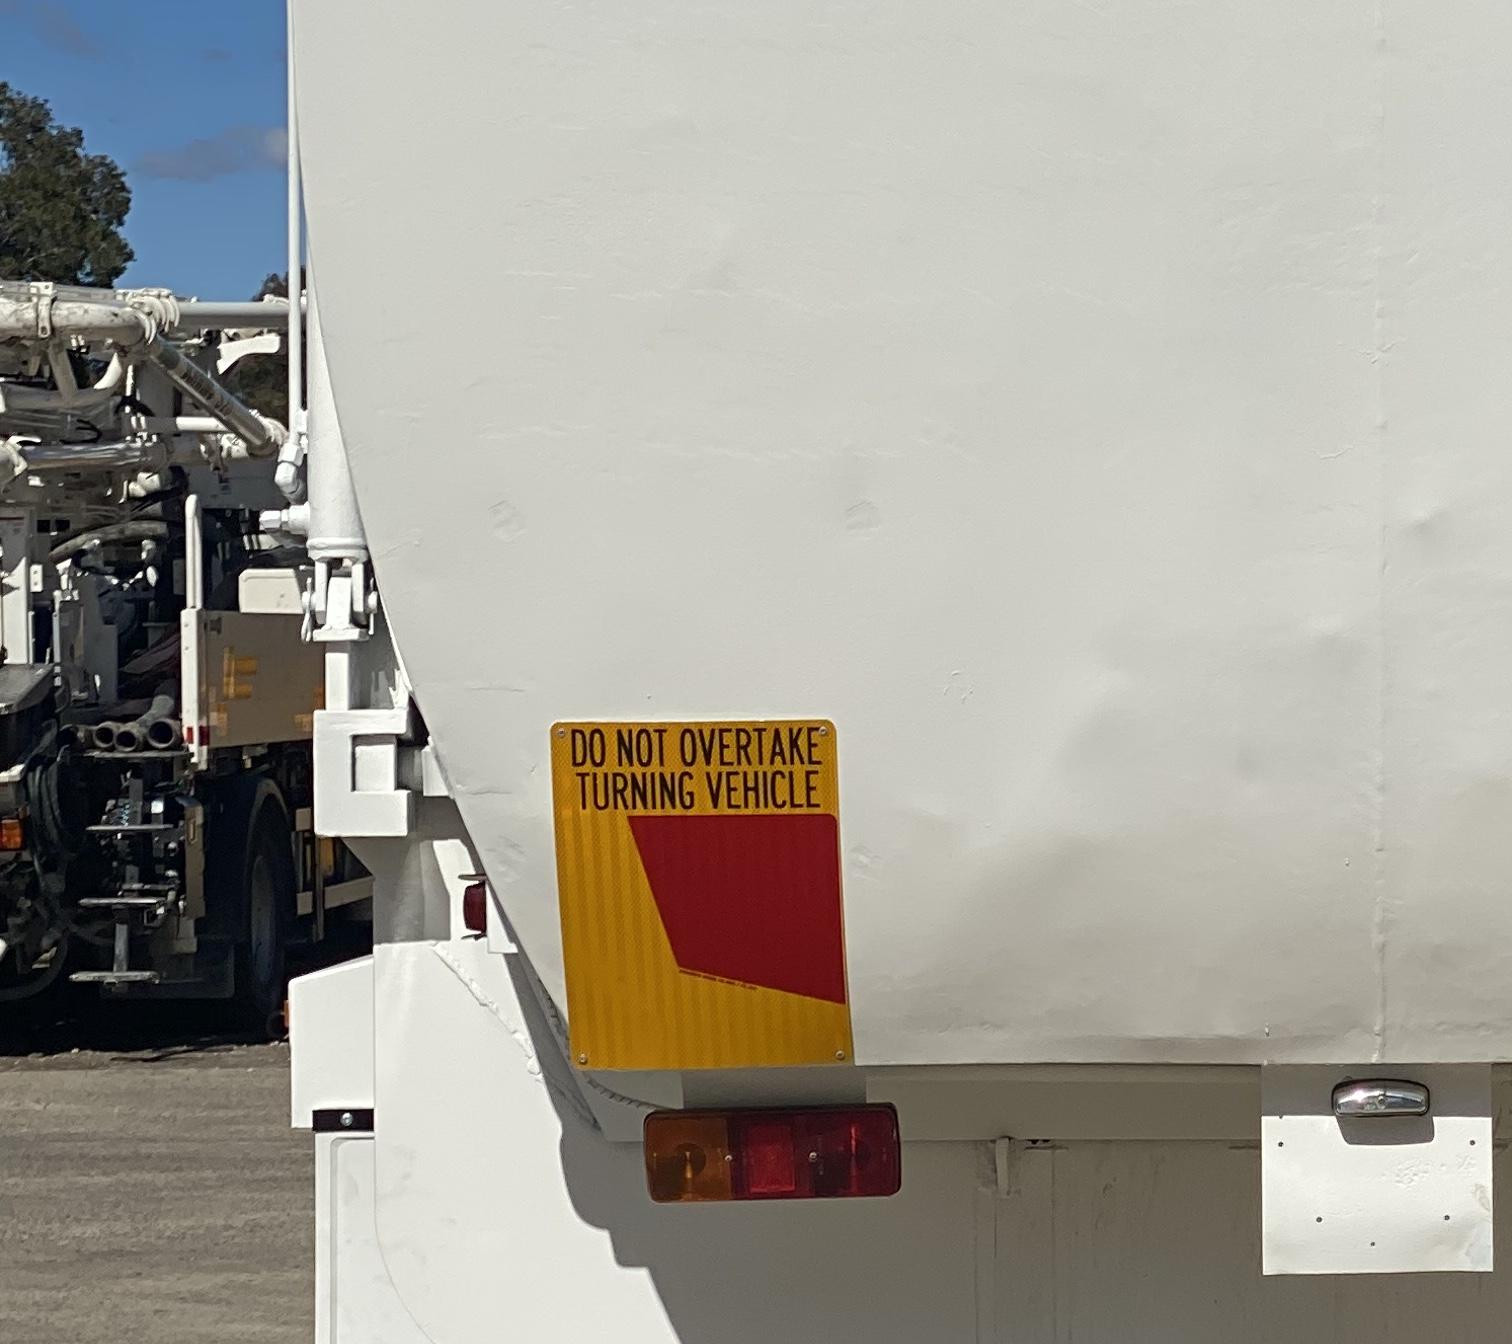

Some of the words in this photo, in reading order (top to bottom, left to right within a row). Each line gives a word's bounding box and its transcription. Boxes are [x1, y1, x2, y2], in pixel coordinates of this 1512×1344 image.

[570, 728, 606, 768] DO
[616, 728, 667, 767] NOT
[679, 727, 823, 766] OVERTAKE
[575, 771, 695, 810] TURNING
[705, 770, 821, 809] VEHICLE
